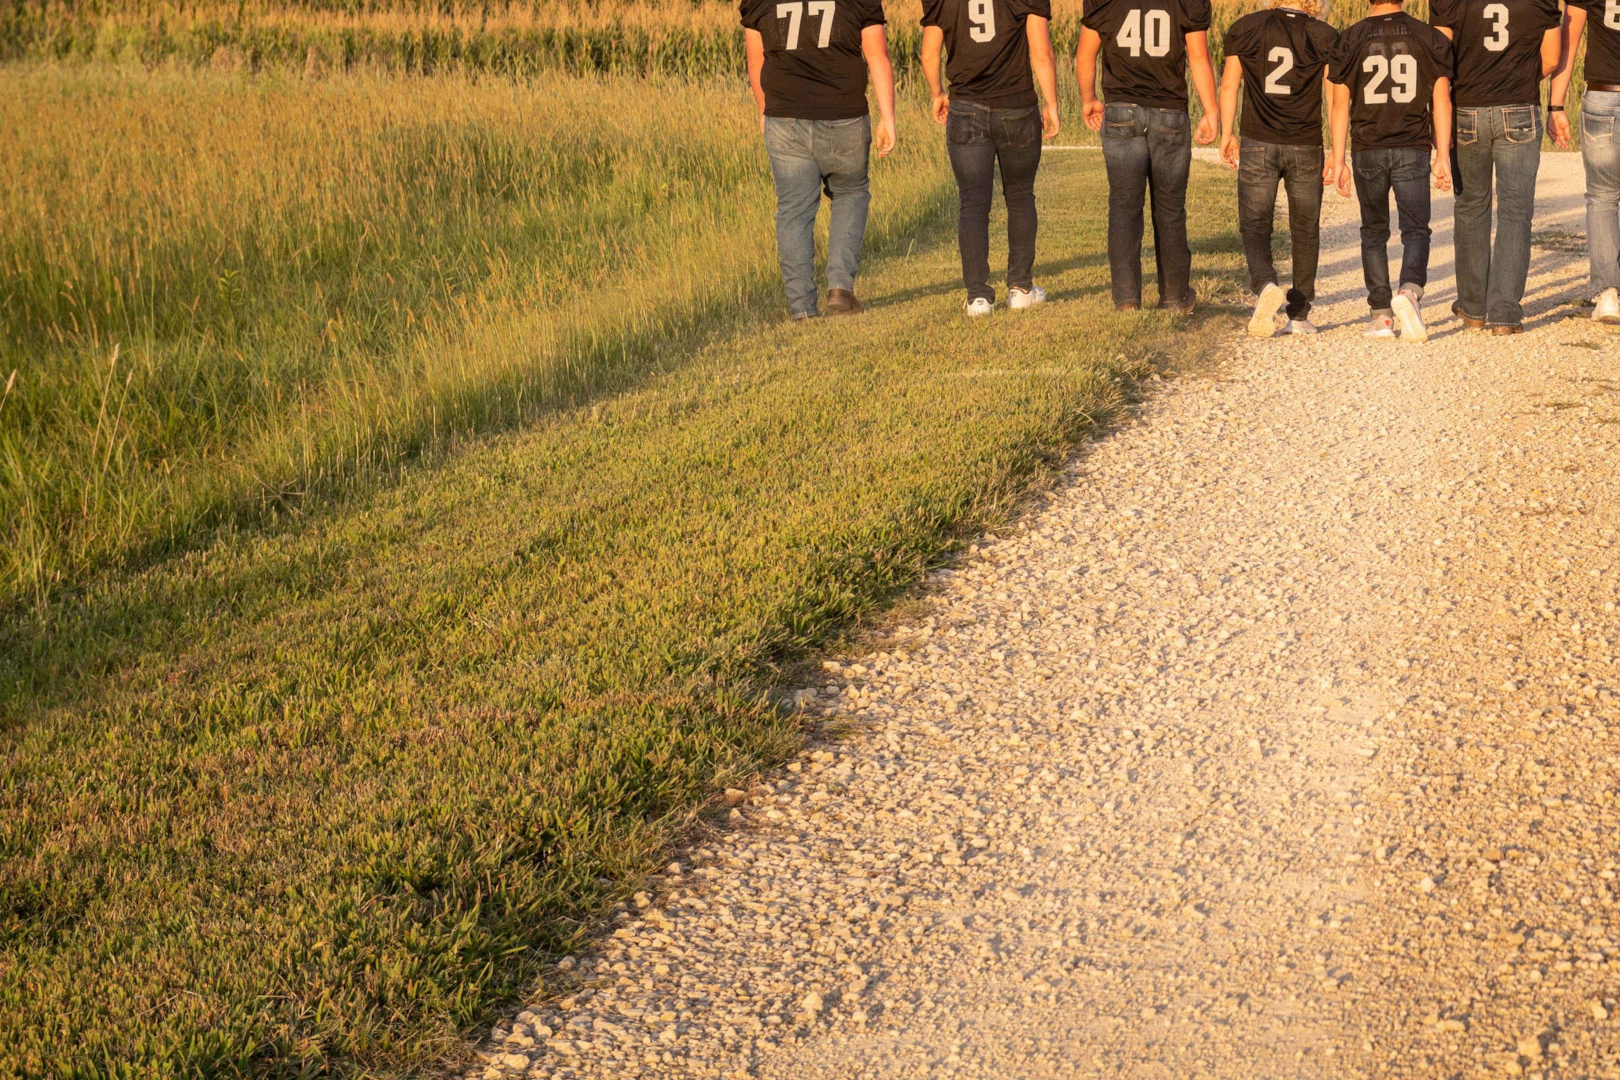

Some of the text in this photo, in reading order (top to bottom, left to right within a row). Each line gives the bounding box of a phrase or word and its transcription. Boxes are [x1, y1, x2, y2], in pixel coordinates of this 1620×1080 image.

[776, 0, 836, 50] 77
[1116, 9, 1171, 57] 40
[1483, 3, 1509, 52] 3
[1265, 46, 1294, 95] 2
[1362, 54, 1418, 104] 29
